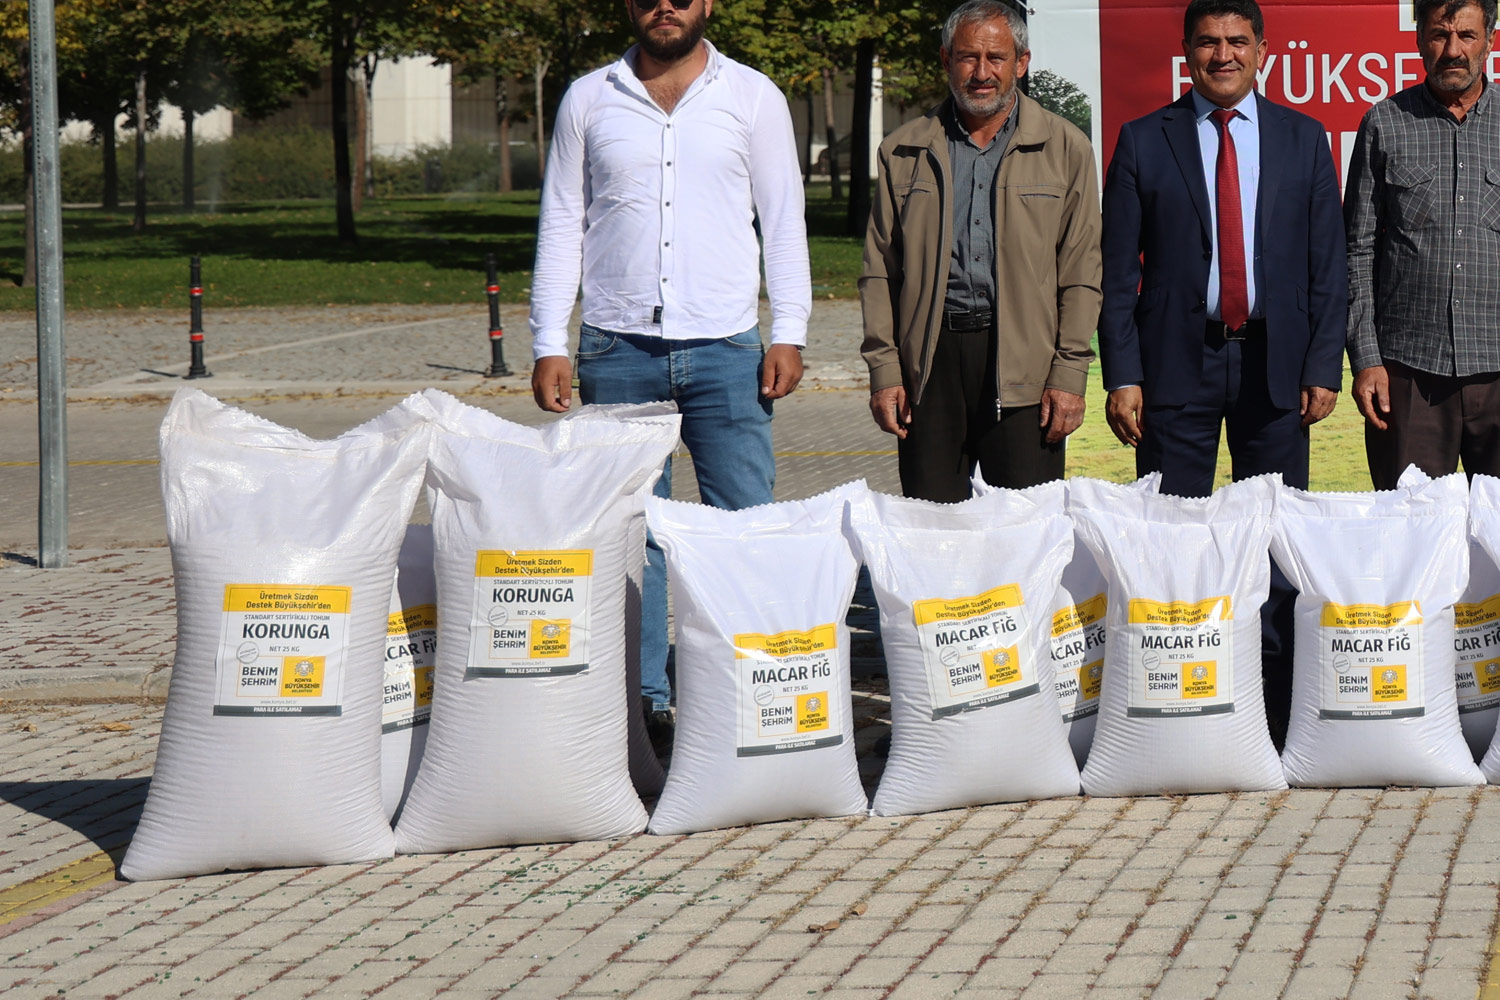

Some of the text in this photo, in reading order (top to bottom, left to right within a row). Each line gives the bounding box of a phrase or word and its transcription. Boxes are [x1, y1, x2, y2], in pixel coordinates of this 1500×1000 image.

[507, 558, 536, 566] Üretmek
[260, 591, 318, 601] Üretmek Sizden
[493, 588, 574, 603] KORUNGA
[246, 601, 331, 610] Destek Büyükşehir'den
[936, 601, 1005, 619] Destek Büyükşehir'den
[945, 598, 992, 611] Üretmek Sizden
[1147, 614, 1168, 622] Destek
[1346, 611, 1372, 619] Üretmek
[1464, 608, 1484, 617] Sizden
[242, 623, 330, 639] KORUNGA
[936, 624, 989, 647] MACAR
[1141, 635, 1194, 650] MACAR
[1332, 638, 1383, 652] MACAR
[752, 666, 808, 685] MACAR
